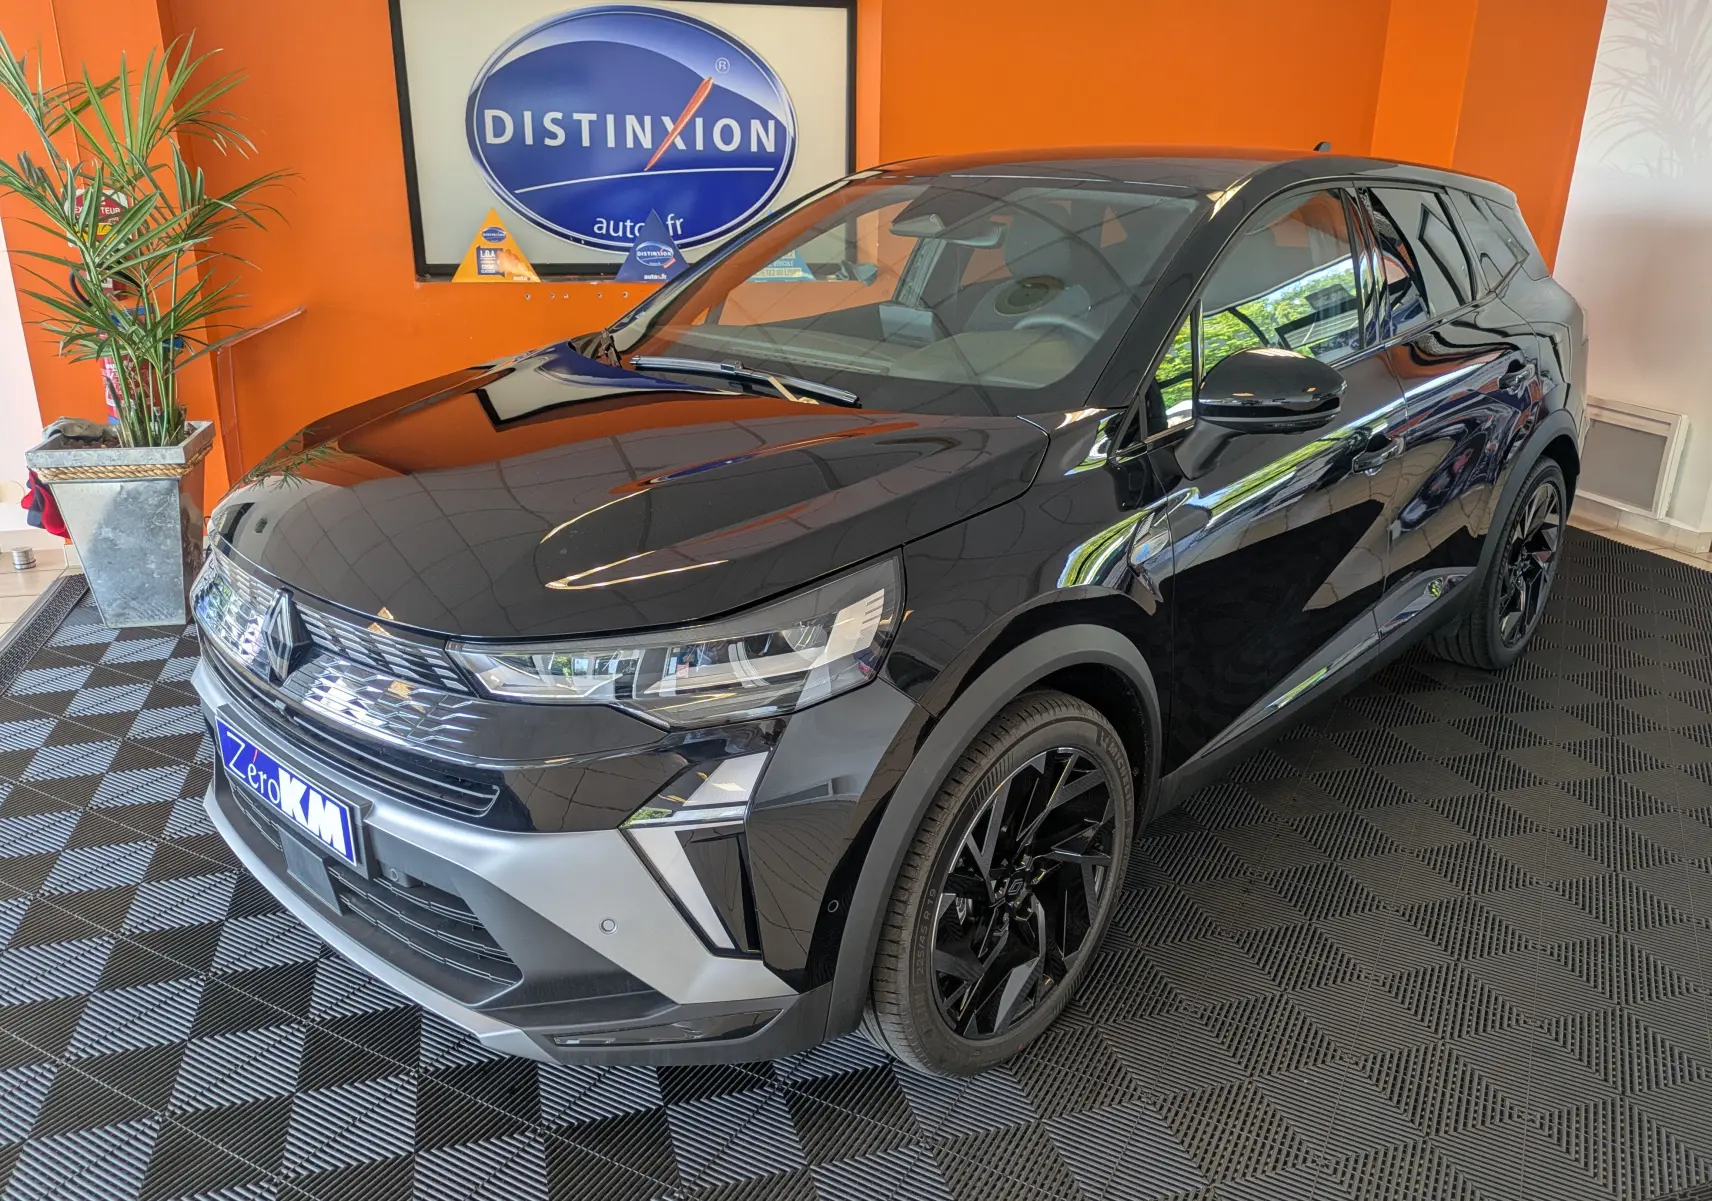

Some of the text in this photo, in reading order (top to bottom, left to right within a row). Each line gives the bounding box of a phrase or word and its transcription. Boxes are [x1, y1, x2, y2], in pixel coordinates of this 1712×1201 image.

[483, 108, 777, 153] DISTINXION
[916, 927, 928, 975] 225/45
[928, 888, 937, 905] 19
